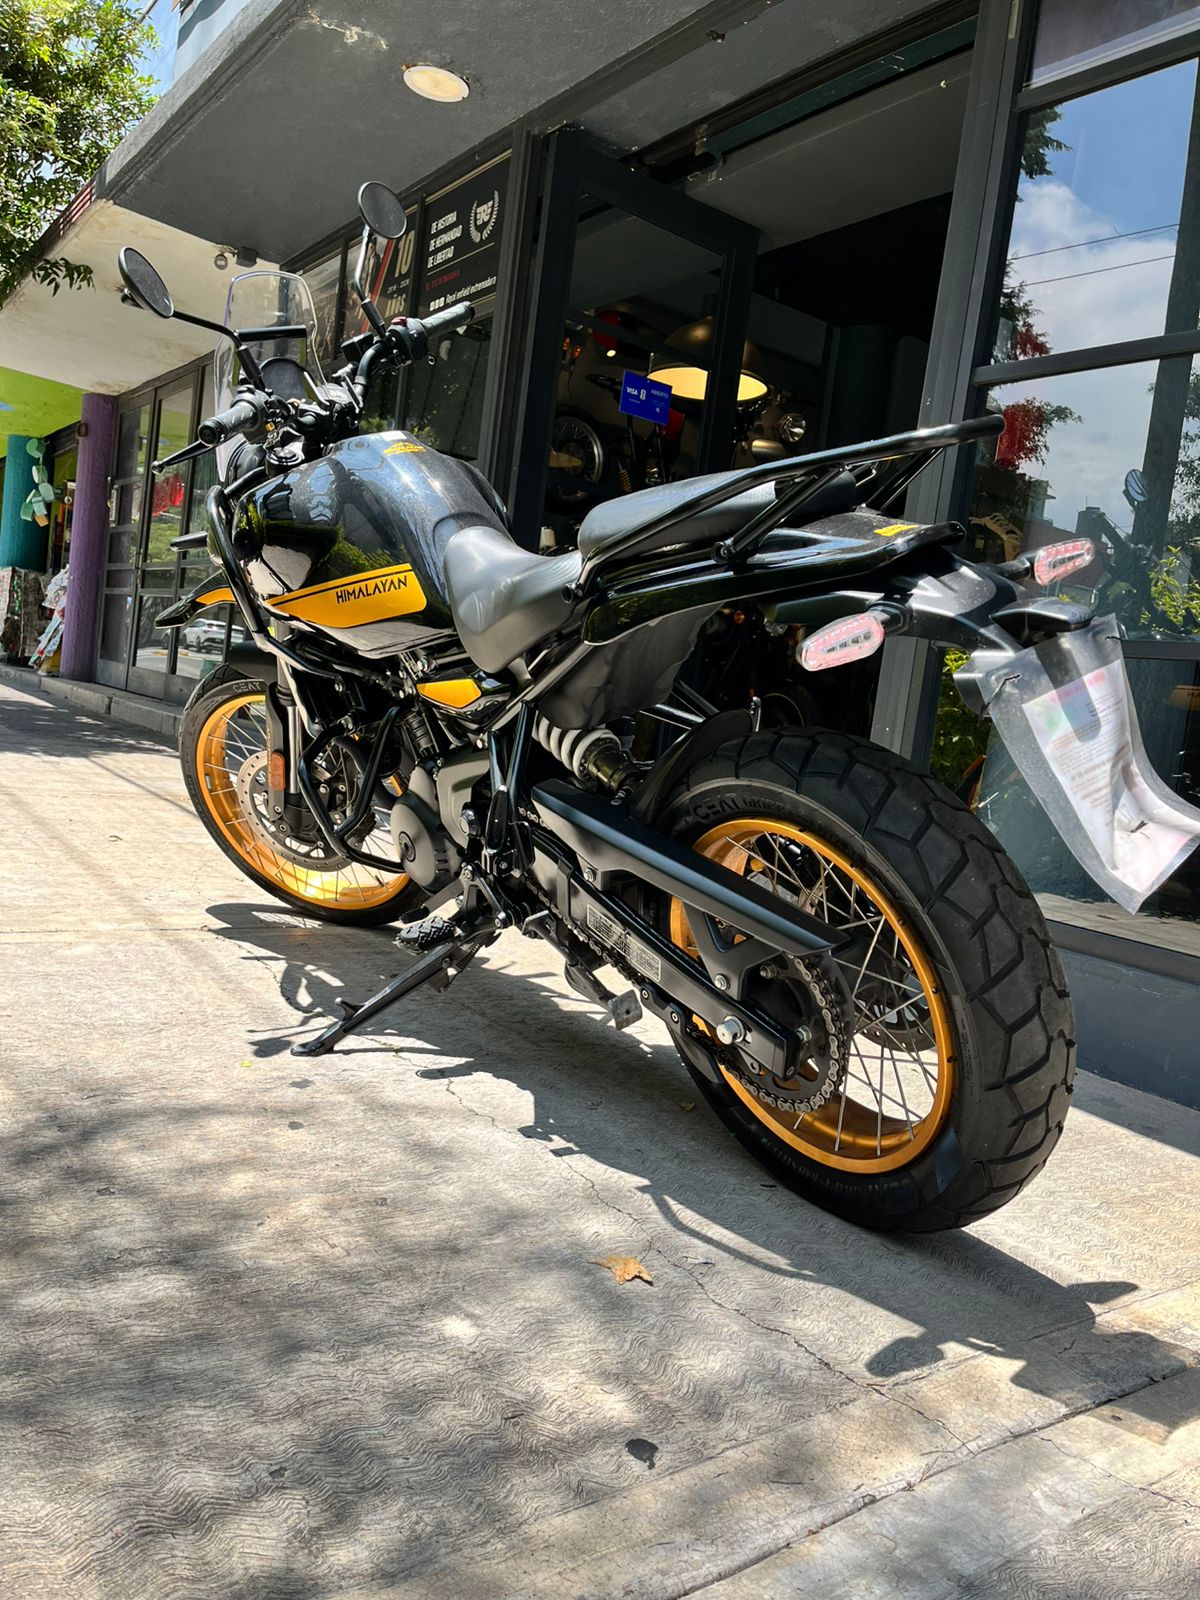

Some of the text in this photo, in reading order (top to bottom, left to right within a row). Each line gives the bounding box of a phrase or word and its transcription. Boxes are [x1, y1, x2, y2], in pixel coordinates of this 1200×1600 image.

[431, 211, 457, 234] DE HISTORIA
[429, 224, 463, 251] DE HERMANDAD
[394, 229, 415, 278] 10
[427, 245, 455, 268] DE LIBERTAD
[470, 276, 497, 294] extremadura
[627, 387, 638, 396] VISA
[336, 575, 408, 604] HIMALAYAN
[233, 681, 261, 693] CEAT
[692, 792, 740, 820] CEAT
